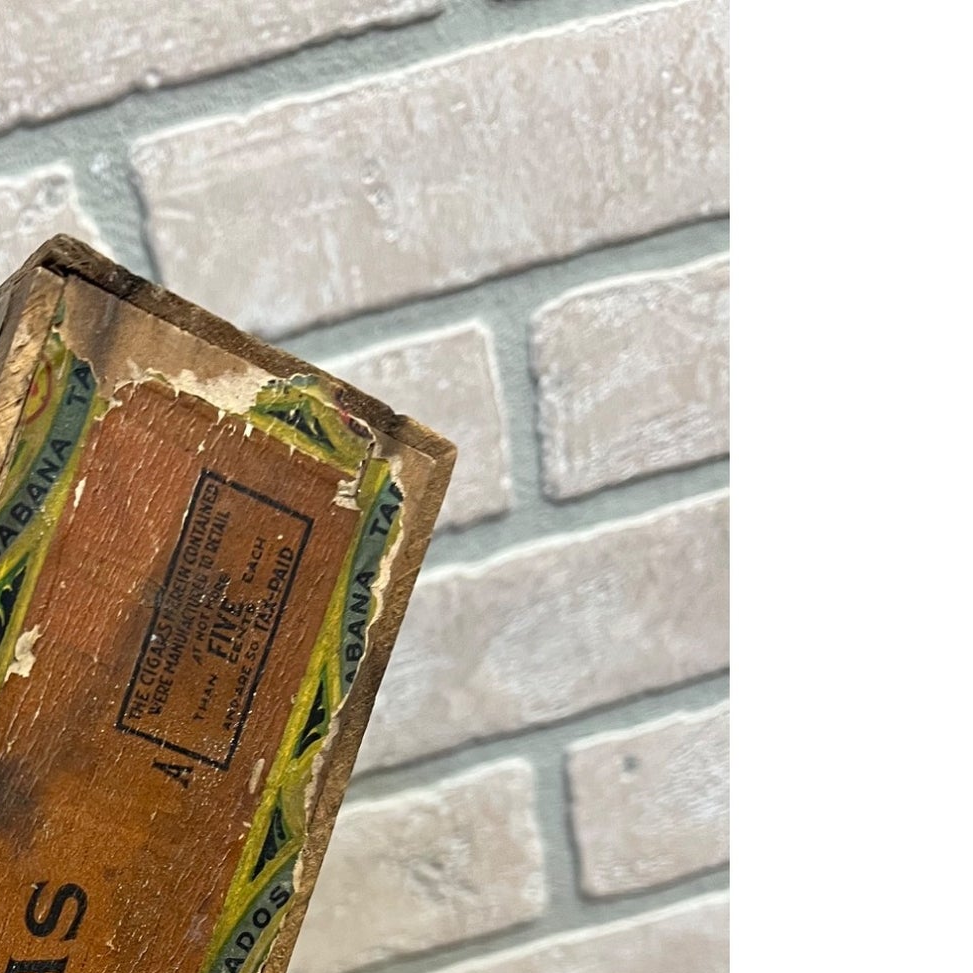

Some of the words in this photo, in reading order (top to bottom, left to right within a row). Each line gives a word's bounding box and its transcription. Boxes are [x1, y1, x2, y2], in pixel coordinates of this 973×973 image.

[205, 510, 230, 553] RETAIL
[198, 553, 214, 570] TO
[128, 690, 149, 719] THE
[140, 621, 172, 686] CIGARS
[183, 484, 218, 565] CONTAINED
[205, 573, 230, 612] MORE
[165, 574, 207, 678] MANUFACTURED
[193, 674, 219, 722] THAN
[208, 598, 243, 659] FIVE
[242, 536, 267, 584] EACH
[195, 618, 211, 643] NOT
[223, 700, 240, 731] AND
[233, 665, 253, 699] ARE
[247, 640, 259, 664] SO
[258, 547, 294, 633] TAX-PAID
[193, 649, 203, 666] AT
[149, 681, 173, 715] WERE
[151, 759, 194, 789] A
